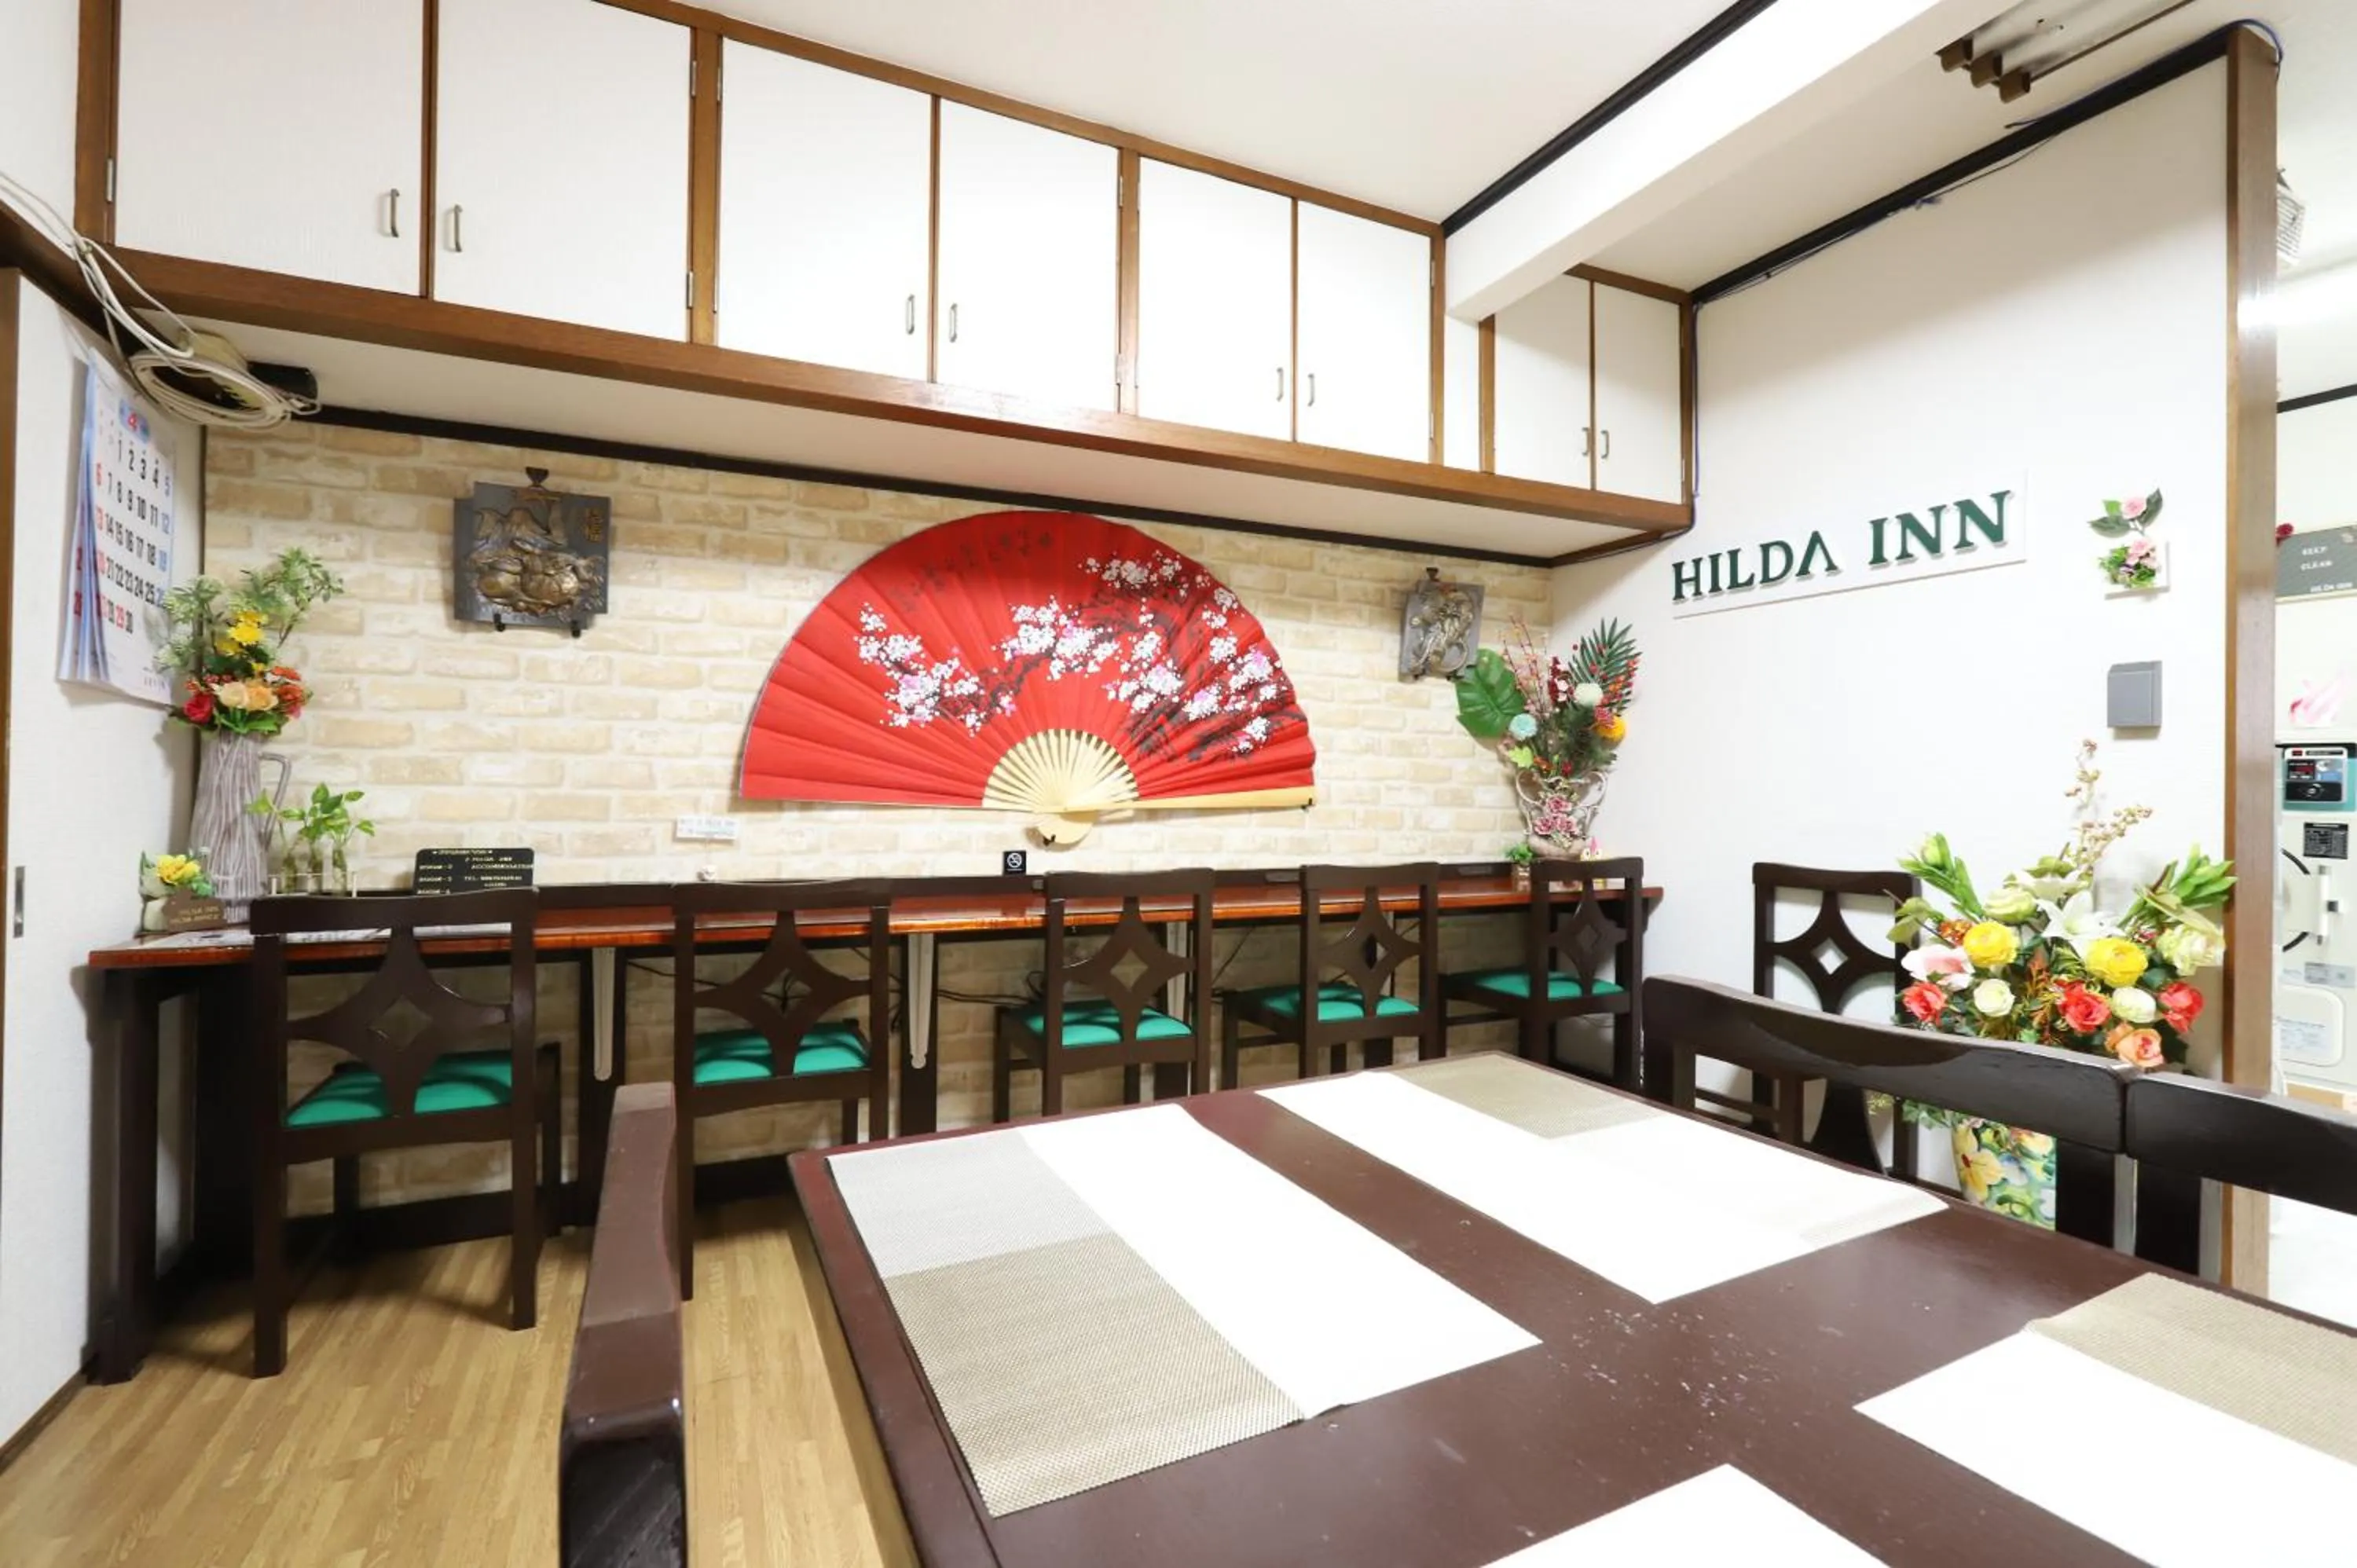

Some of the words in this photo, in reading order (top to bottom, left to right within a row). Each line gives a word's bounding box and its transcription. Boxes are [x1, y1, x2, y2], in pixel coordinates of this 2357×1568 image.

[96, 462, 102, 487] 6
[108, 471, 112, 495] 7
[116, 481, 123, 504] 8
[127, 489, 133, 511] 9
[137, 496, 147, 520] 10
[150, 504, 159, 528] 11
[161, 512, 170, 535] 12
[128, 449, 135, 472] 2
[140, 457, 147, 481] 3
[152, 467, 159, 489] 4
[164, 474, 170, 498] 5
[95, 507, 104, 531] 13
[104, 513, 115, 540] 14
[115, 520, 124, 547] 15
[126, 528, 134, 553] 16
[136, 536, 145, 560] 17
[147, 543, 156, 566] 18
[1671, 530, 1839, 602] HILDA
[1868, 489, 2011, 566] INN
[106, 556, 115, 581] 21
[115, 563, 124, 588] 22
[125, 569, 134, 593] 23
[134, 575, 144, 600] 24
[145, 582, 156, 605] 25
[115, 604, 124, 629] 29
[125, 610, 134, 634] 30
